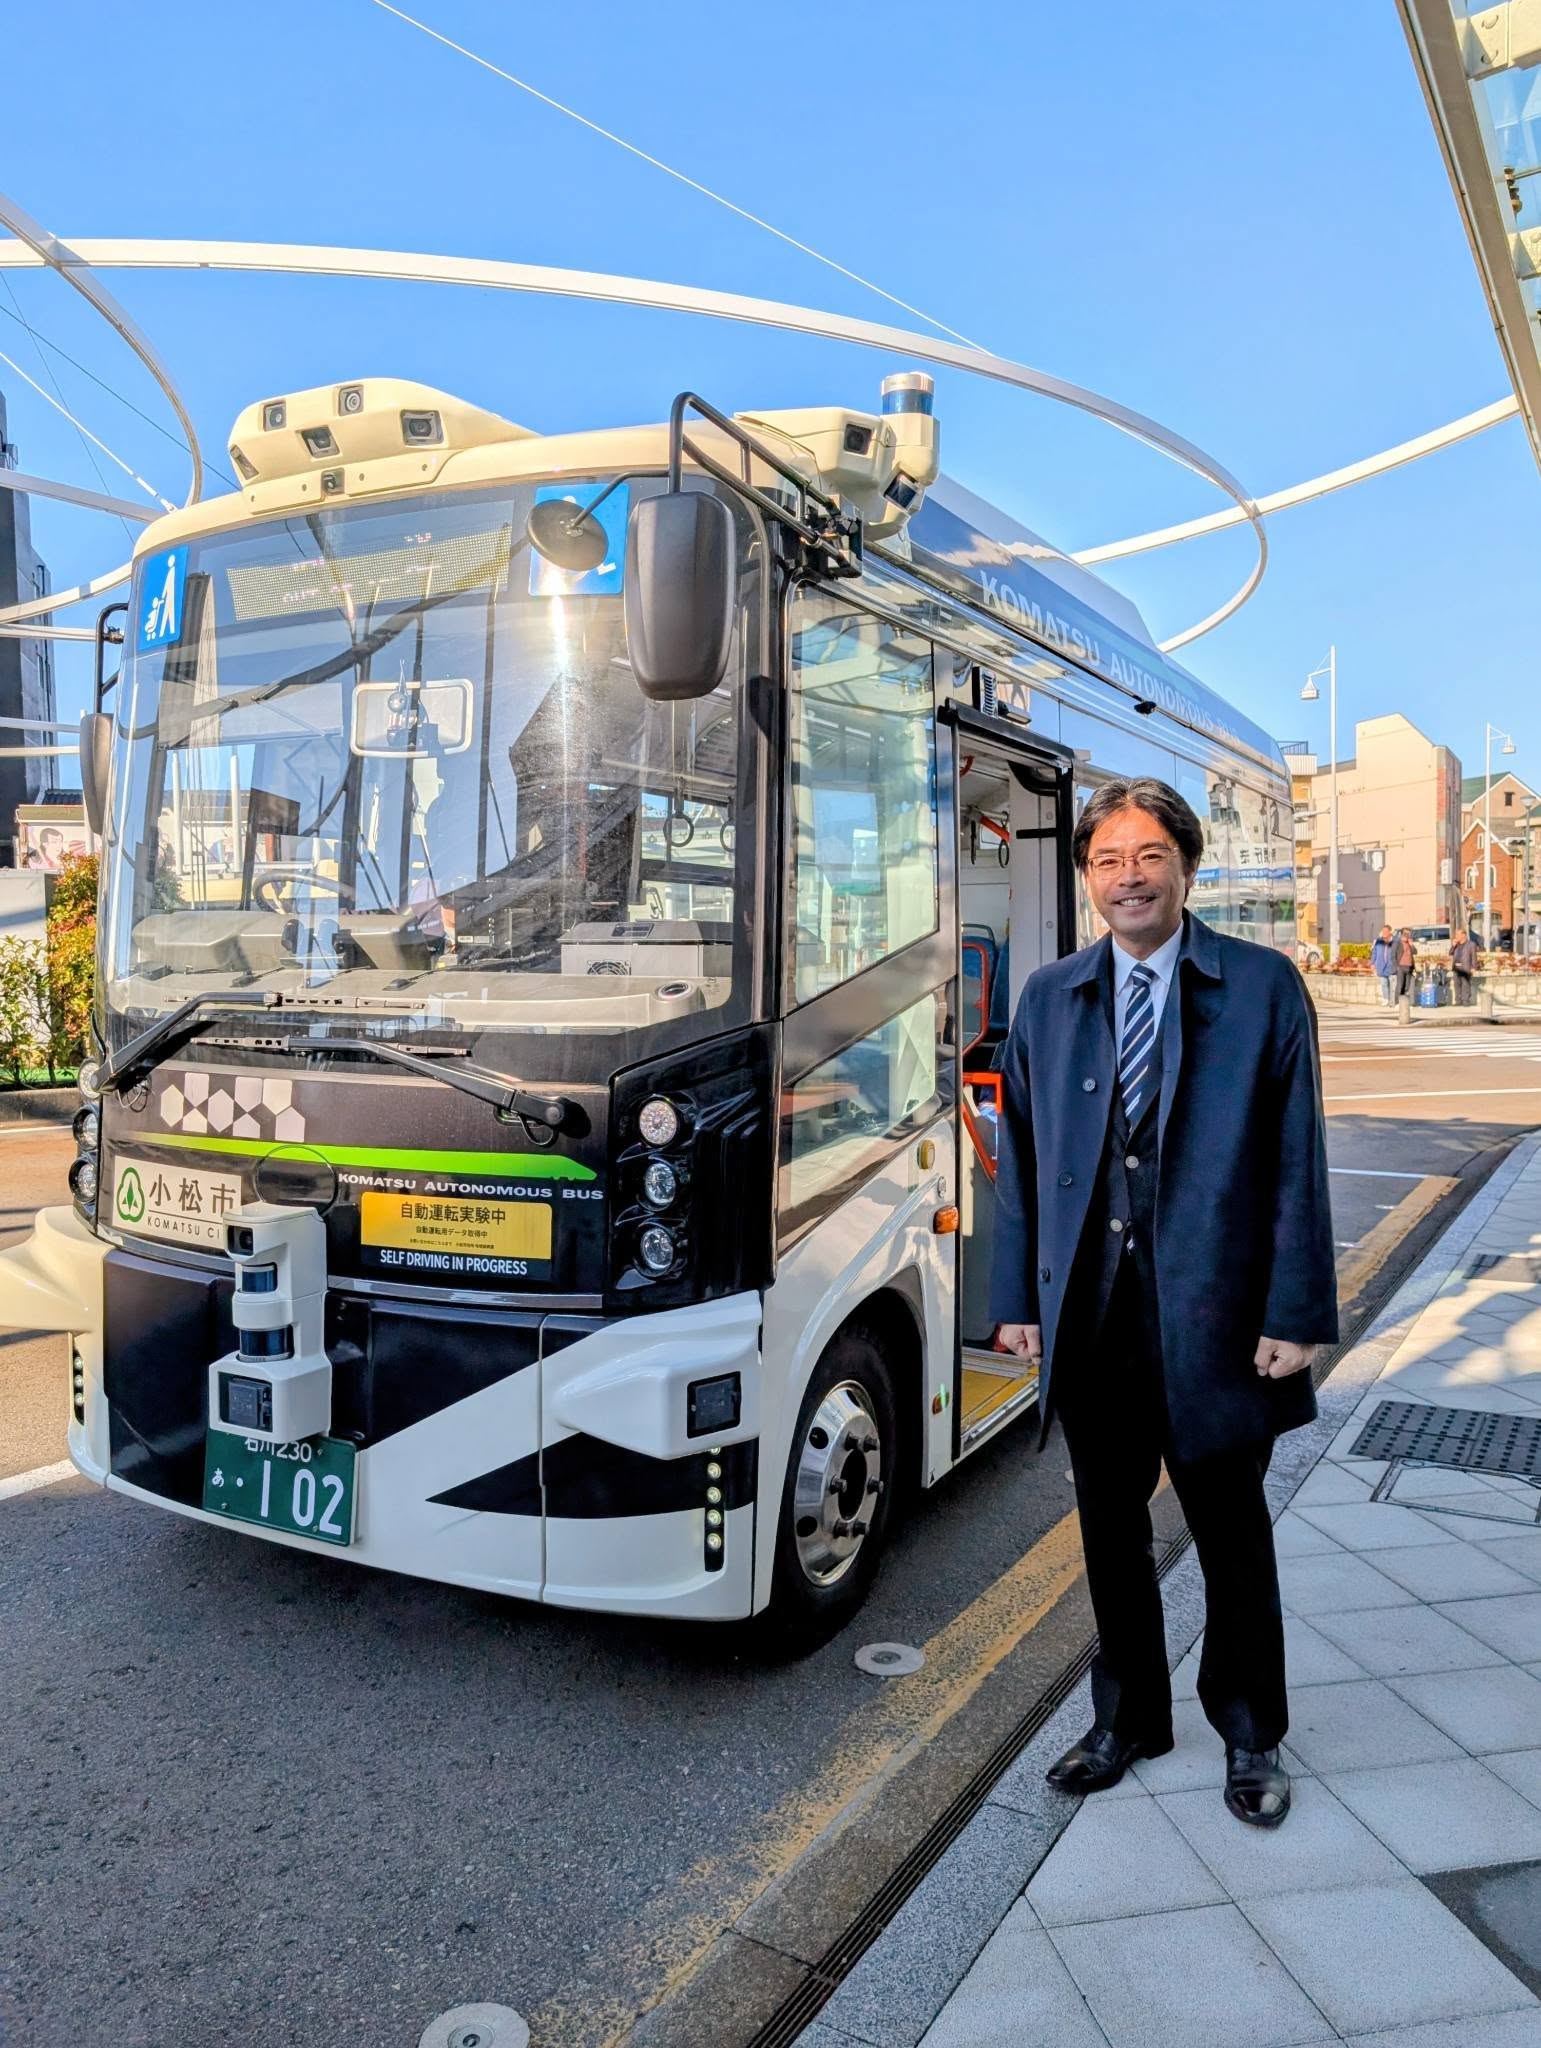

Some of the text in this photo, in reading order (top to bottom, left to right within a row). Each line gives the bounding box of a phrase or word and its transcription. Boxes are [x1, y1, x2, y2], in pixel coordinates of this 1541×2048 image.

[980, 570, 1100, 666] KOMATSU
[1110, 651, 1213, 733] AUTONOMOUS
[148, 1173, 237, 1217] 小松市
[338, 1173, 604, 1200] KOMATSU AUTONOMOUS BUS
[401, 1201, 507, 1226] 自動運転実験中
[147, 1216, 220, 1240] KOMATSU CI
[415, 1225, 489, 1239] 自動運転用データ取得中
[380, 1249, 528, 1276] SELF DRIVING IN PROGRESS
